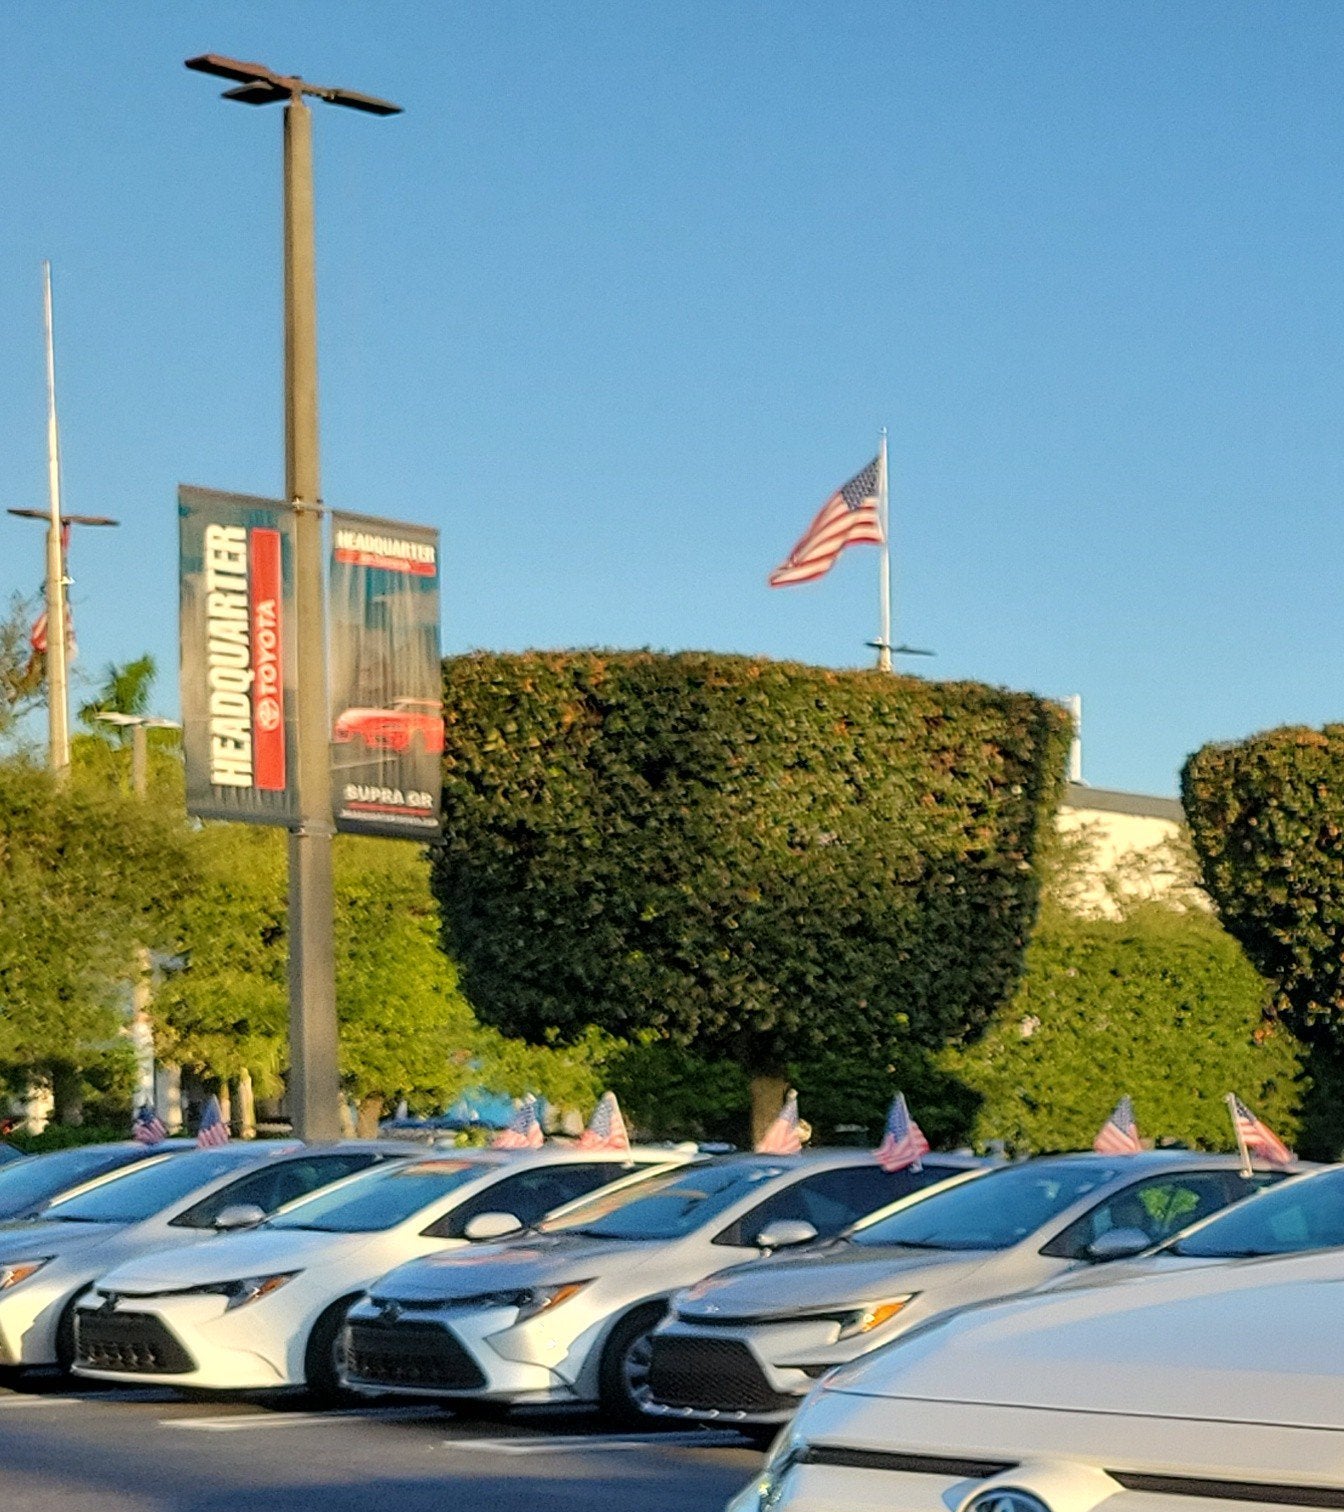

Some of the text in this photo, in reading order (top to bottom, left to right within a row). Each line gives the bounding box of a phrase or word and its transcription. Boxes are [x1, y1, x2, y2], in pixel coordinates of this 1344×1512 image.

[336, 529, 435, 563] HEADQUARTER
[206, 523, 254, 788] HEADQUARTER
[256, 600, 279, 698] TOYOTA
[343, 783, 404, 805] SUPRA
